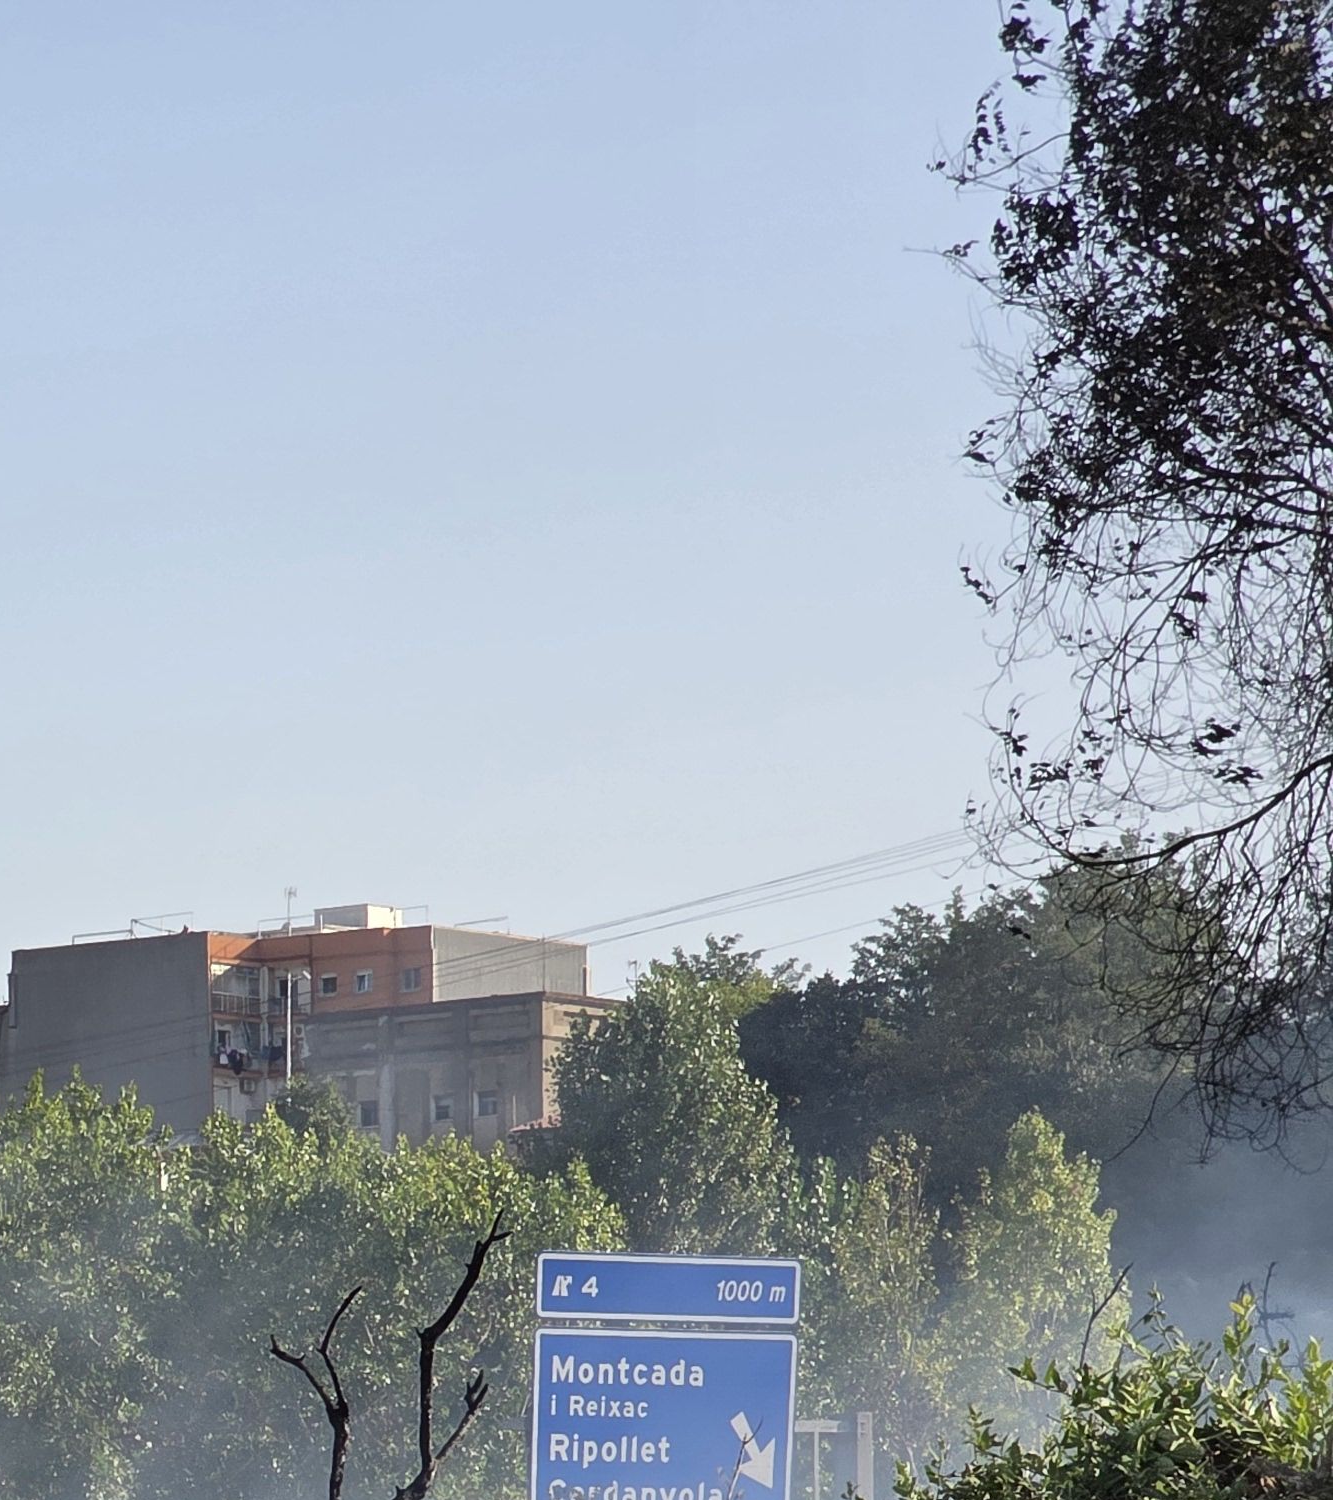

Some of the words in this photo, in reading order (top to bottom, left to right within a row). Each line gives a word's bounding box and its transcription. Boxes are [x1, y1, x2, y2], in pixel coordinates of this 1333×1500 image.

[581, 1276, 599, 1297] 4
[717, 1280, 763, 1302] 1000
[769, 1285, 786, 1303] m
[551, 1355, 704, 1387] Montcada
[550, 1394, 557, 1416] i
[569, 1395, 649, 1418] Reixac
[549, 1433, 670, 1469] Ripollet
